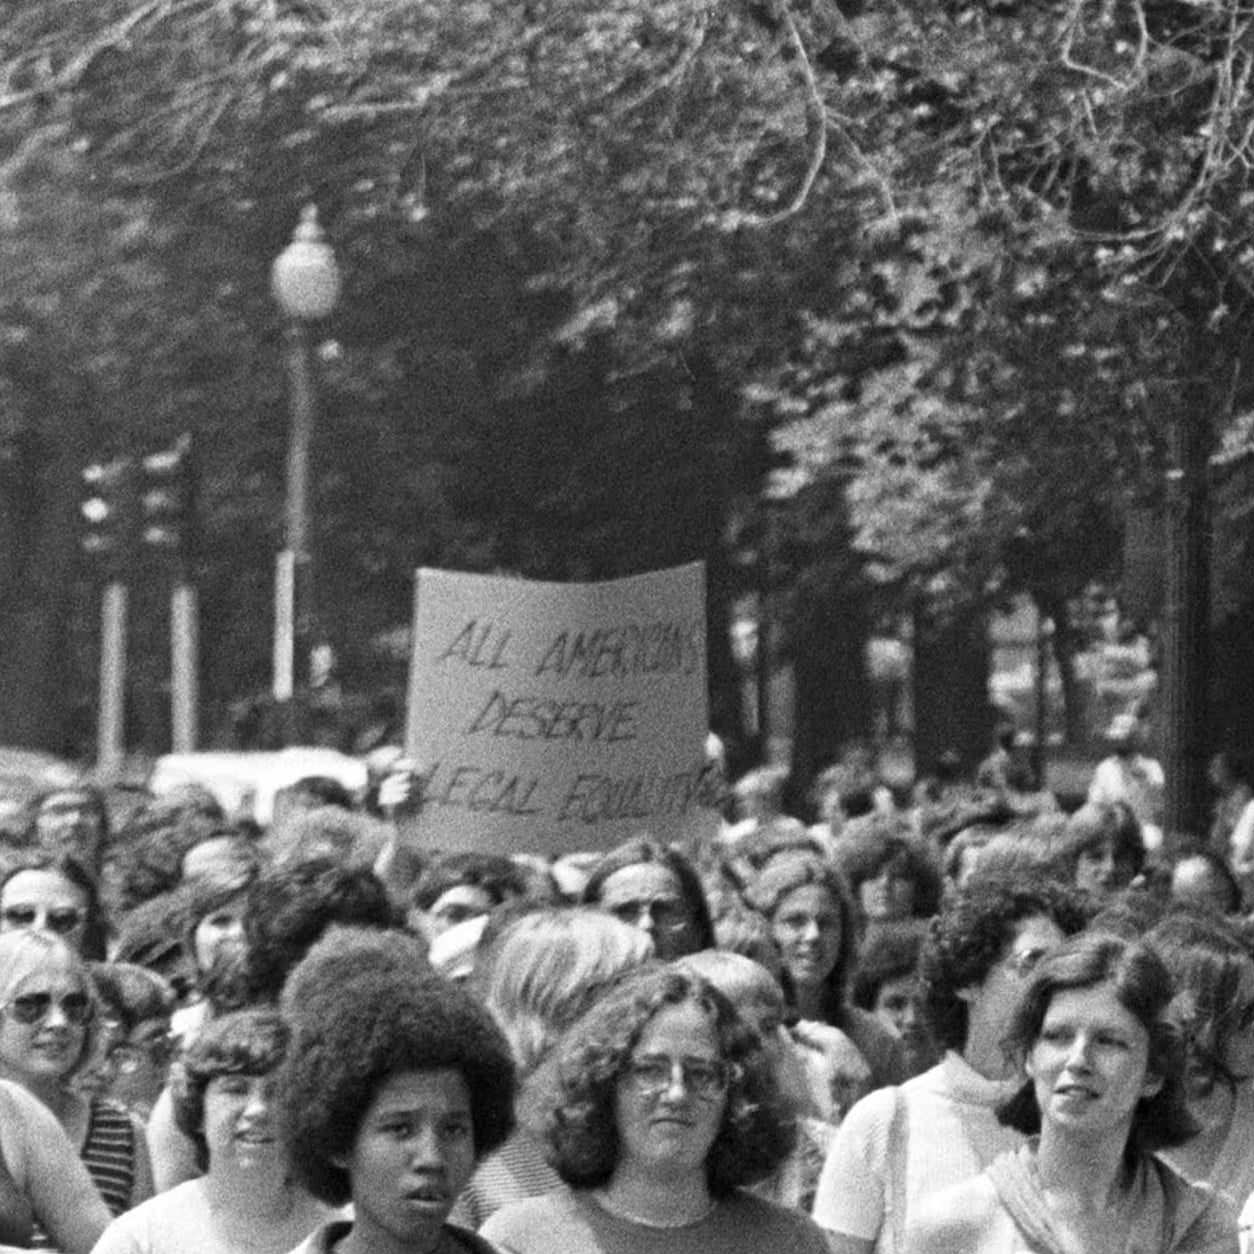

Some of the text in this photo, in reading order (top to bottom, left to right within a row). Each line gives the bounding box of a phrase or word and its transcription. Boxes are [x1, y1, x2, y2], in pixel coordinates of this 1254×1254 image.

[436, 619, 514, 670] ALL
[464, 689, 639, 744] DESERVE
[422, 761, 542, 816] LEGAL
